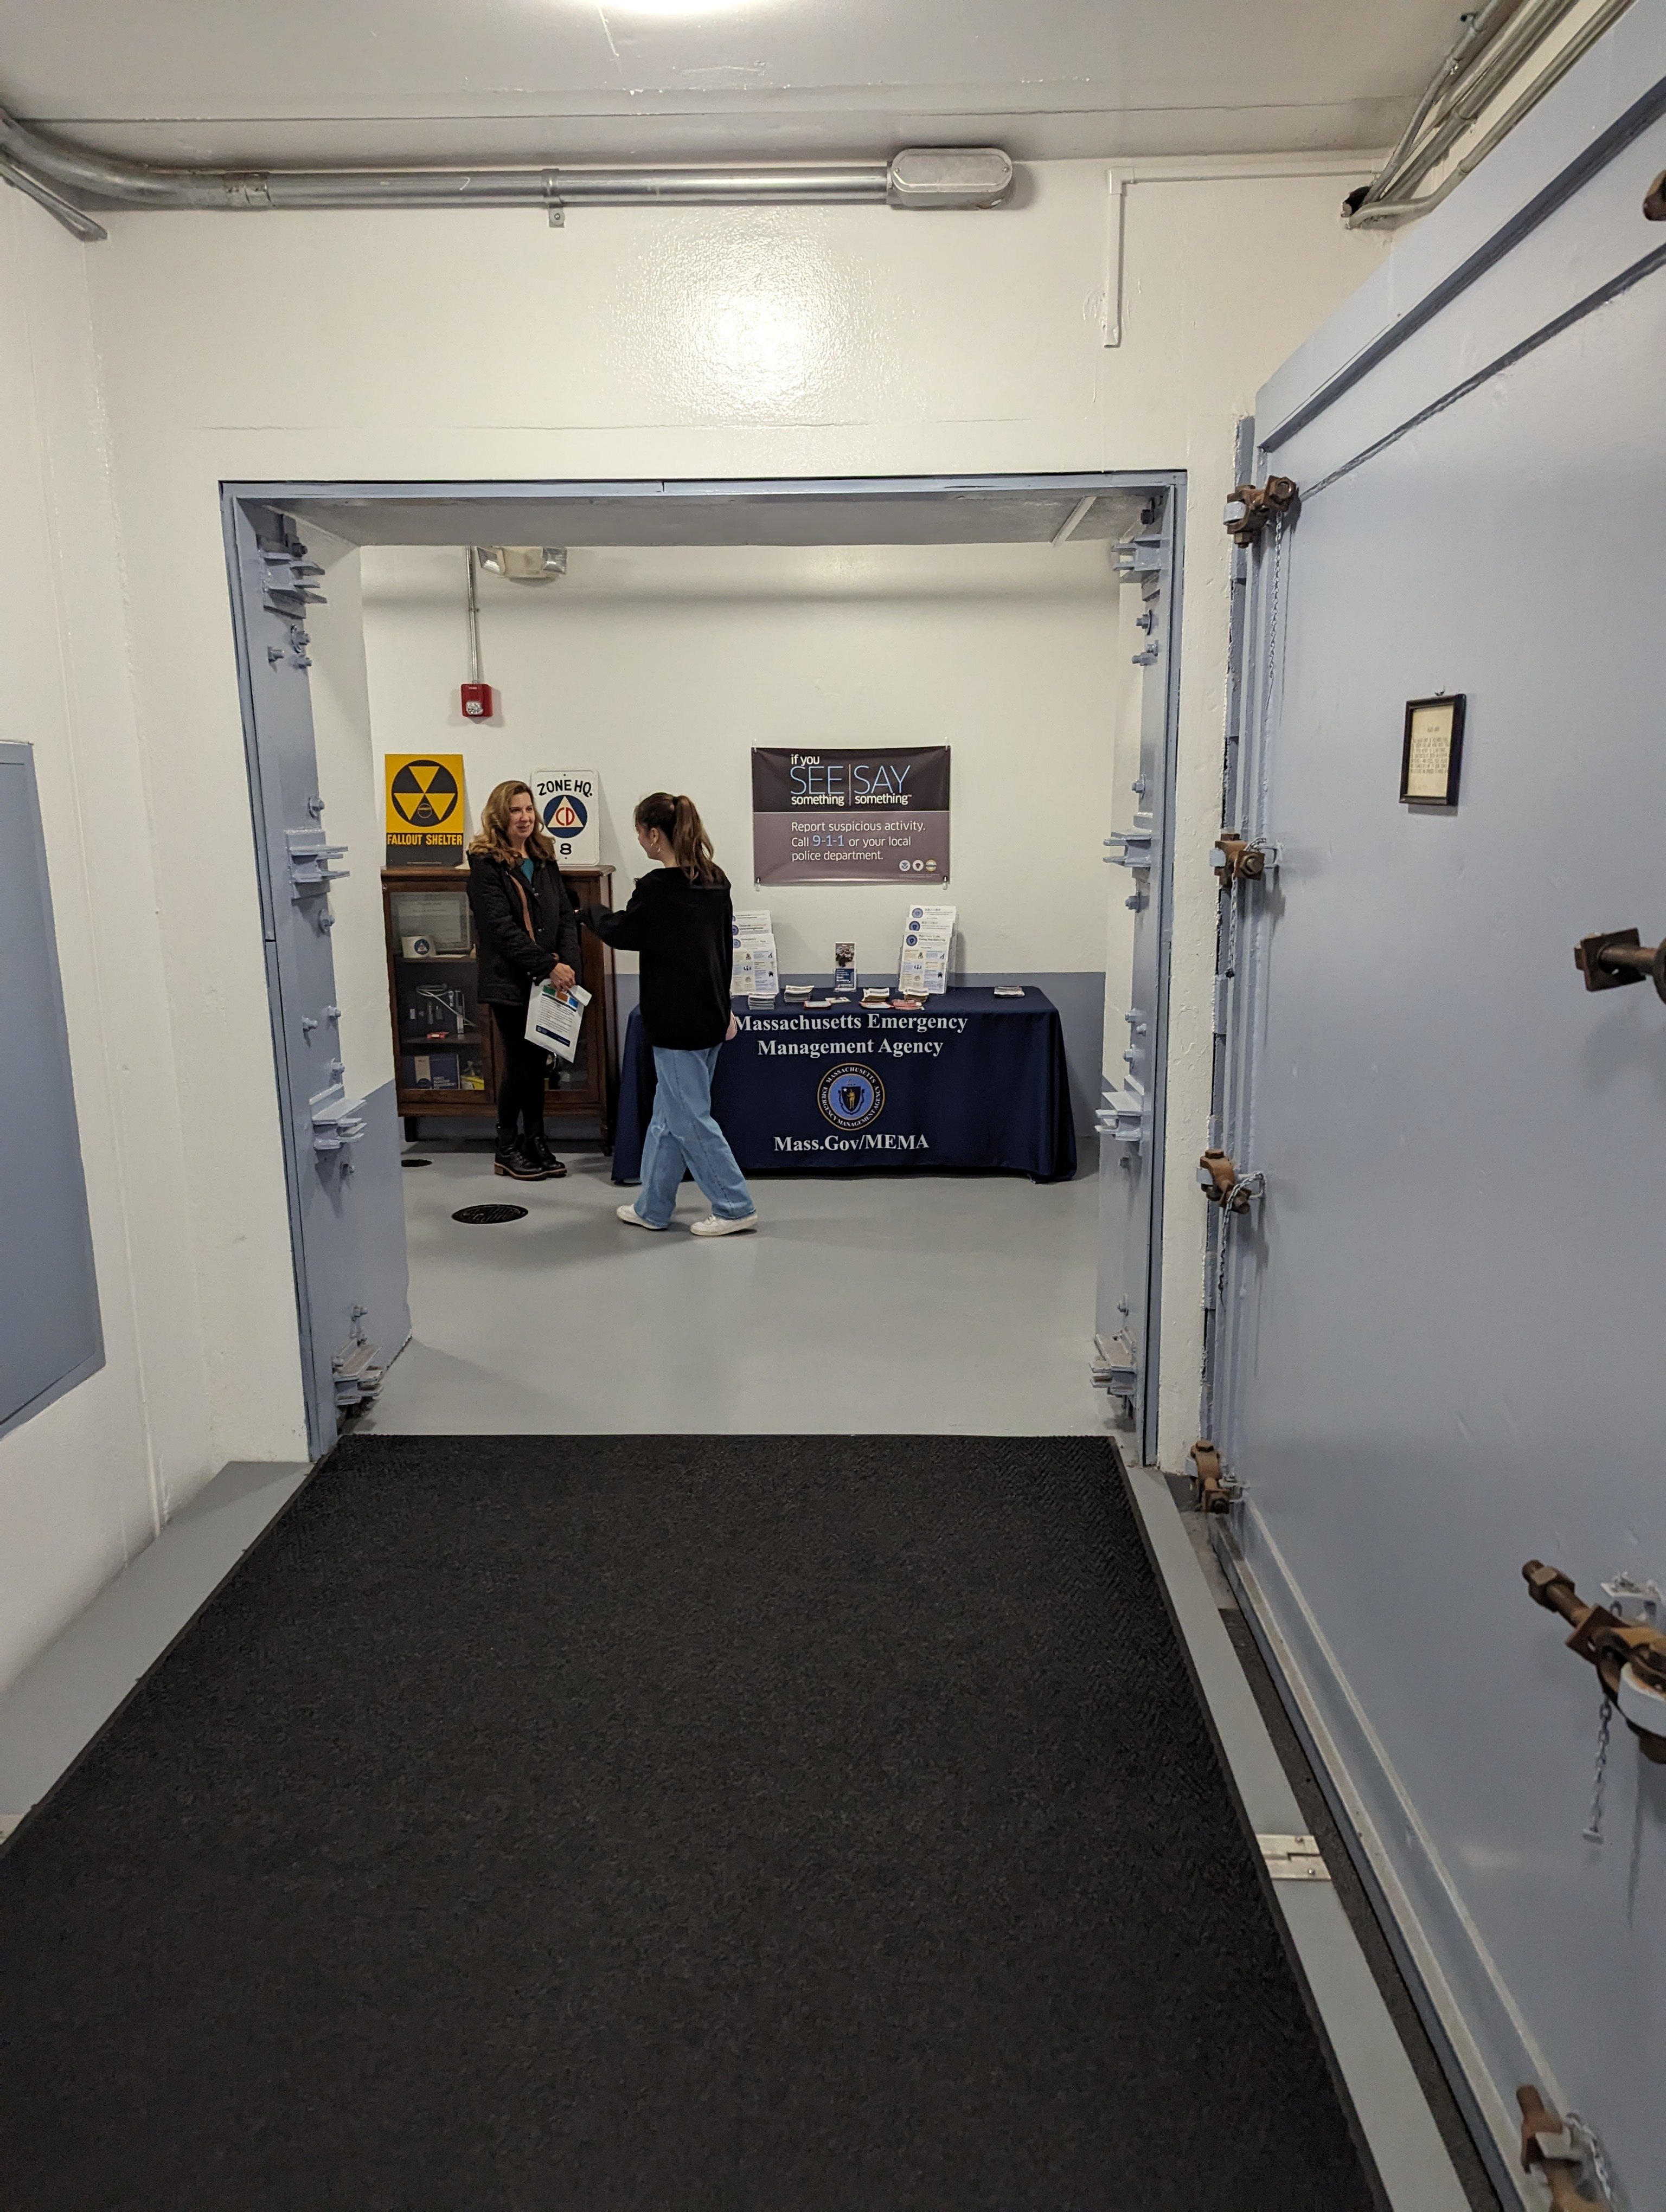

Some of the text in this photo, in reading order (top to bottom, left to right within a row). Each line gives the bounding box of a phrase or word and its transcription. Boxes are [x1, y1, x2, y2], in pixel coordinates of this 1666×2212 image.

[791, 754, 820, 767] if you
[537, 780, 593, 798] ZONE HQ.
[790, 765, 911, 795] SEE SAY
[791, 794, 844, 806] something
[555, 807, 575, 826] CD
[791, 820, 926, 833] Report suspicious activity.
[387, 834, 462, 845] FALLOUT SHELTER
[791, 834, 911, 848] Call 9-1-1 or your local
[560, 843, 572, 855] 8
[792, 850, 883, 862] police department.
[735, 1013, 969, 1033] Massachusetts Emergency
[757, 1038, 944, 1058] Management Agency
[825, 1066, 875, 1084] MASSACHUSETTS
[821, 1086, 837, 1121] EMERGENCY
[837, 1110, 876, 1127] MANAGEMENT
[773, 1134, 930, 1152] Mass.Gov/MEMA
